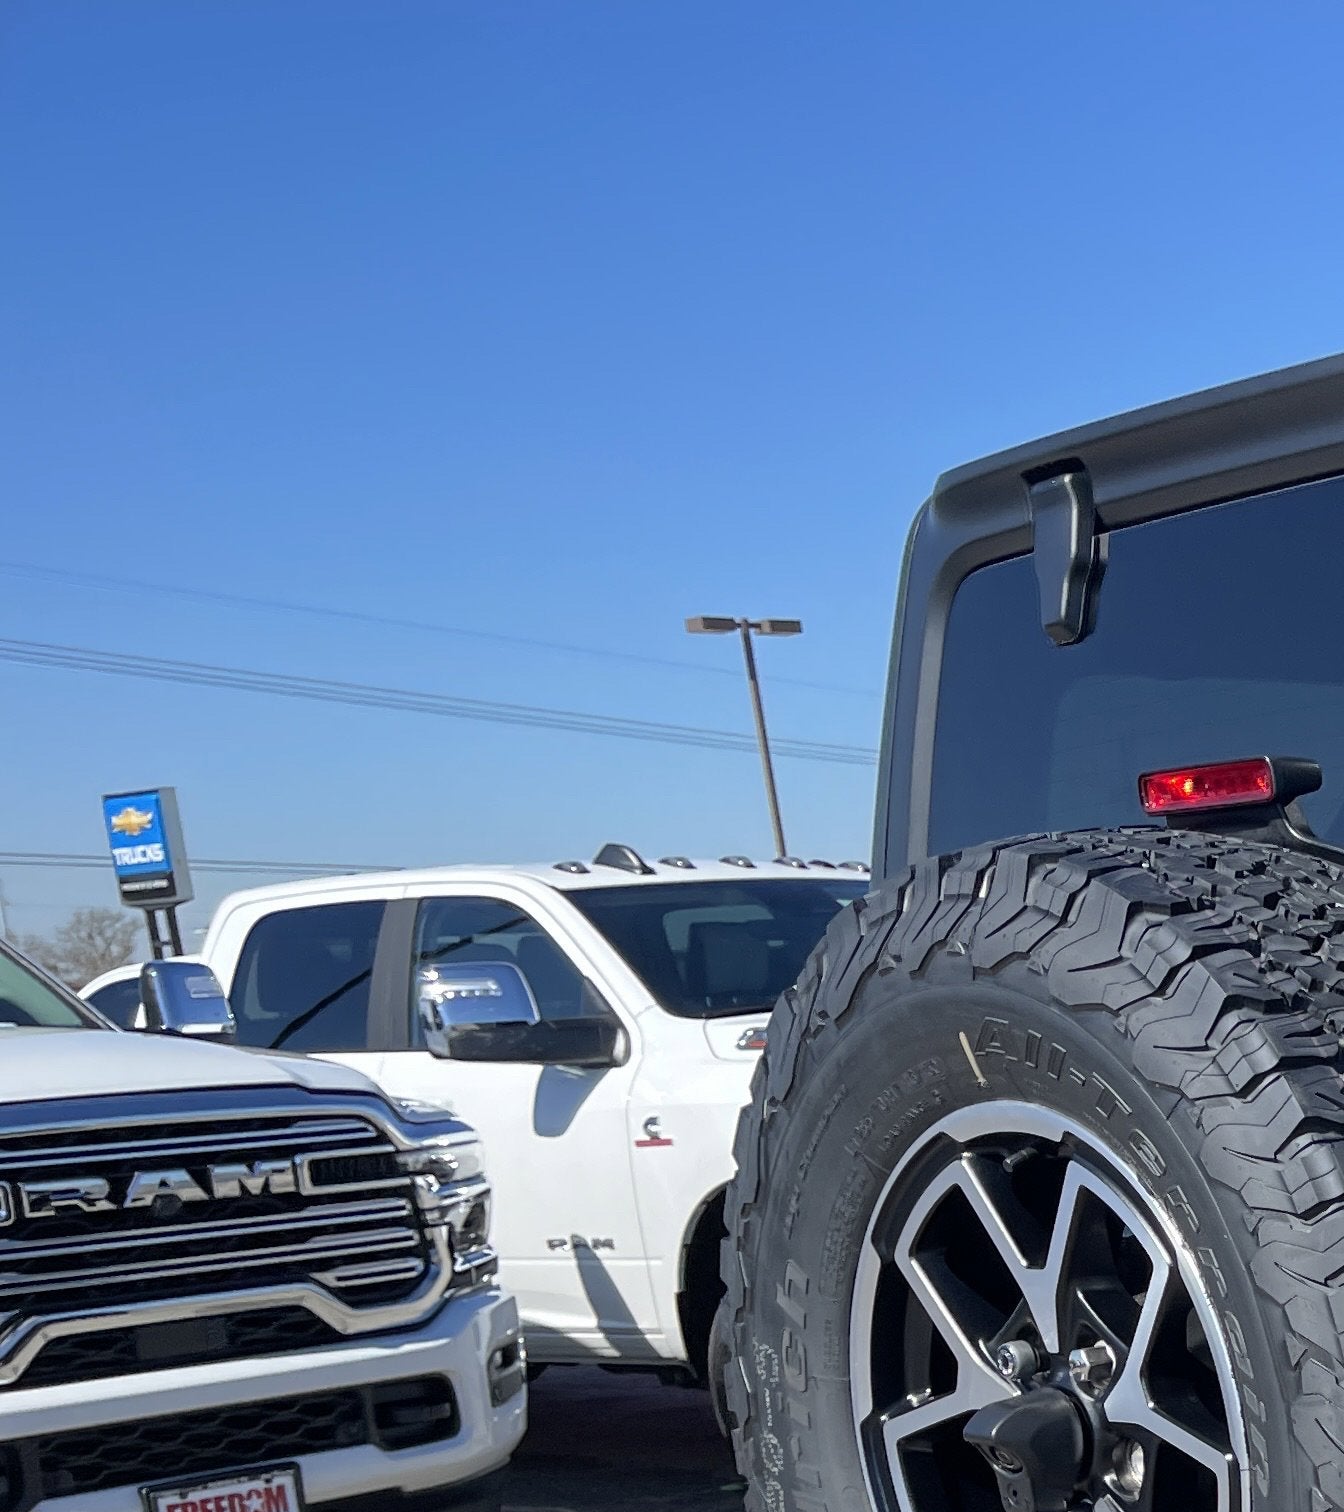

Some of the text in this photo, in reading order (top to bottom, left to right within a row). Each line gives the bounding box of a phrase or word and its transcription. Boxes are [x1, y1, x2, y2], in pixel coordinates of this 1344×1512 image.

[112, 843, 165, 866] TRUCKS
[17, 1159, 298, 1218] RAM
[546, 1237, 616, 1251] RAM
